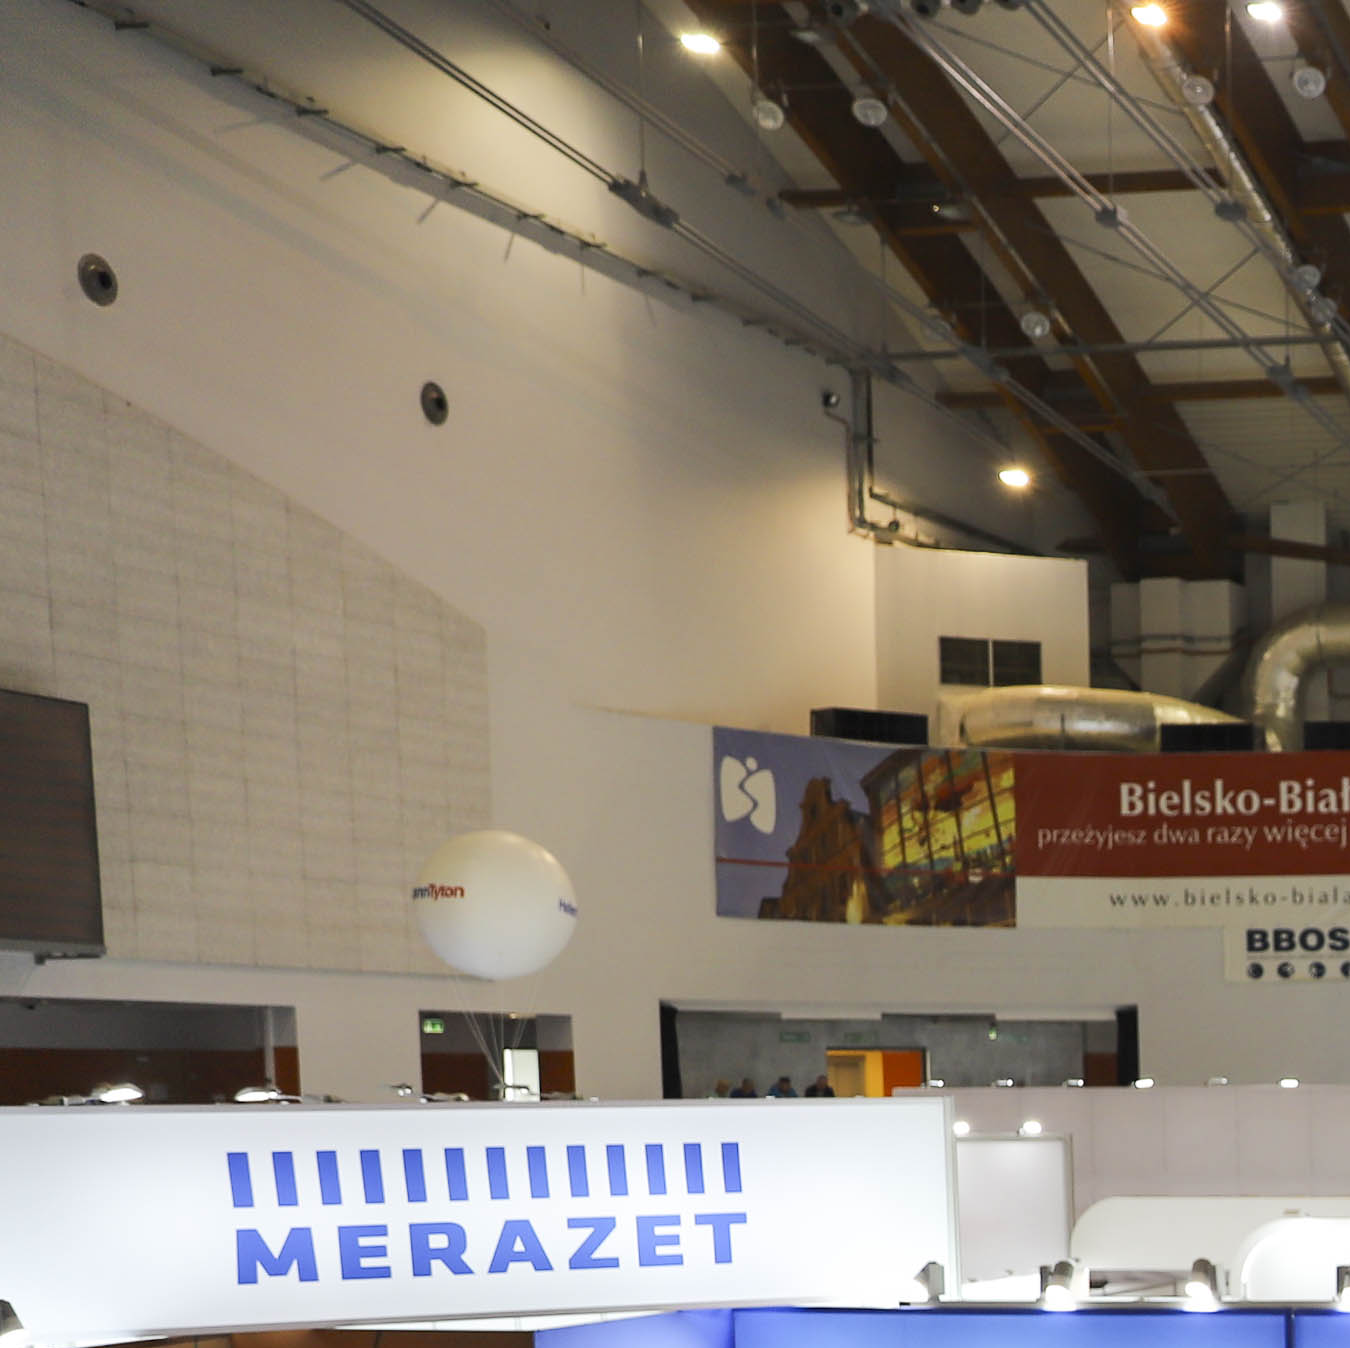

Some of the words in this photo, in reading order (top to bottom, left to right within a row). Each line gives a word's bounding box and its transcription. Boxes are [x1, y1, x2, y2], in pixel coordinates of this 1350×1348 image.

[1038, 824, 1147, 849] przeżyjesz
[1154, 822, 1200, 845] dwa
[1206, 825, 1258, 850] razy
[1263, 819, 1348, 849] więcej
[235, 1211, 748, 1286] MERAZET
